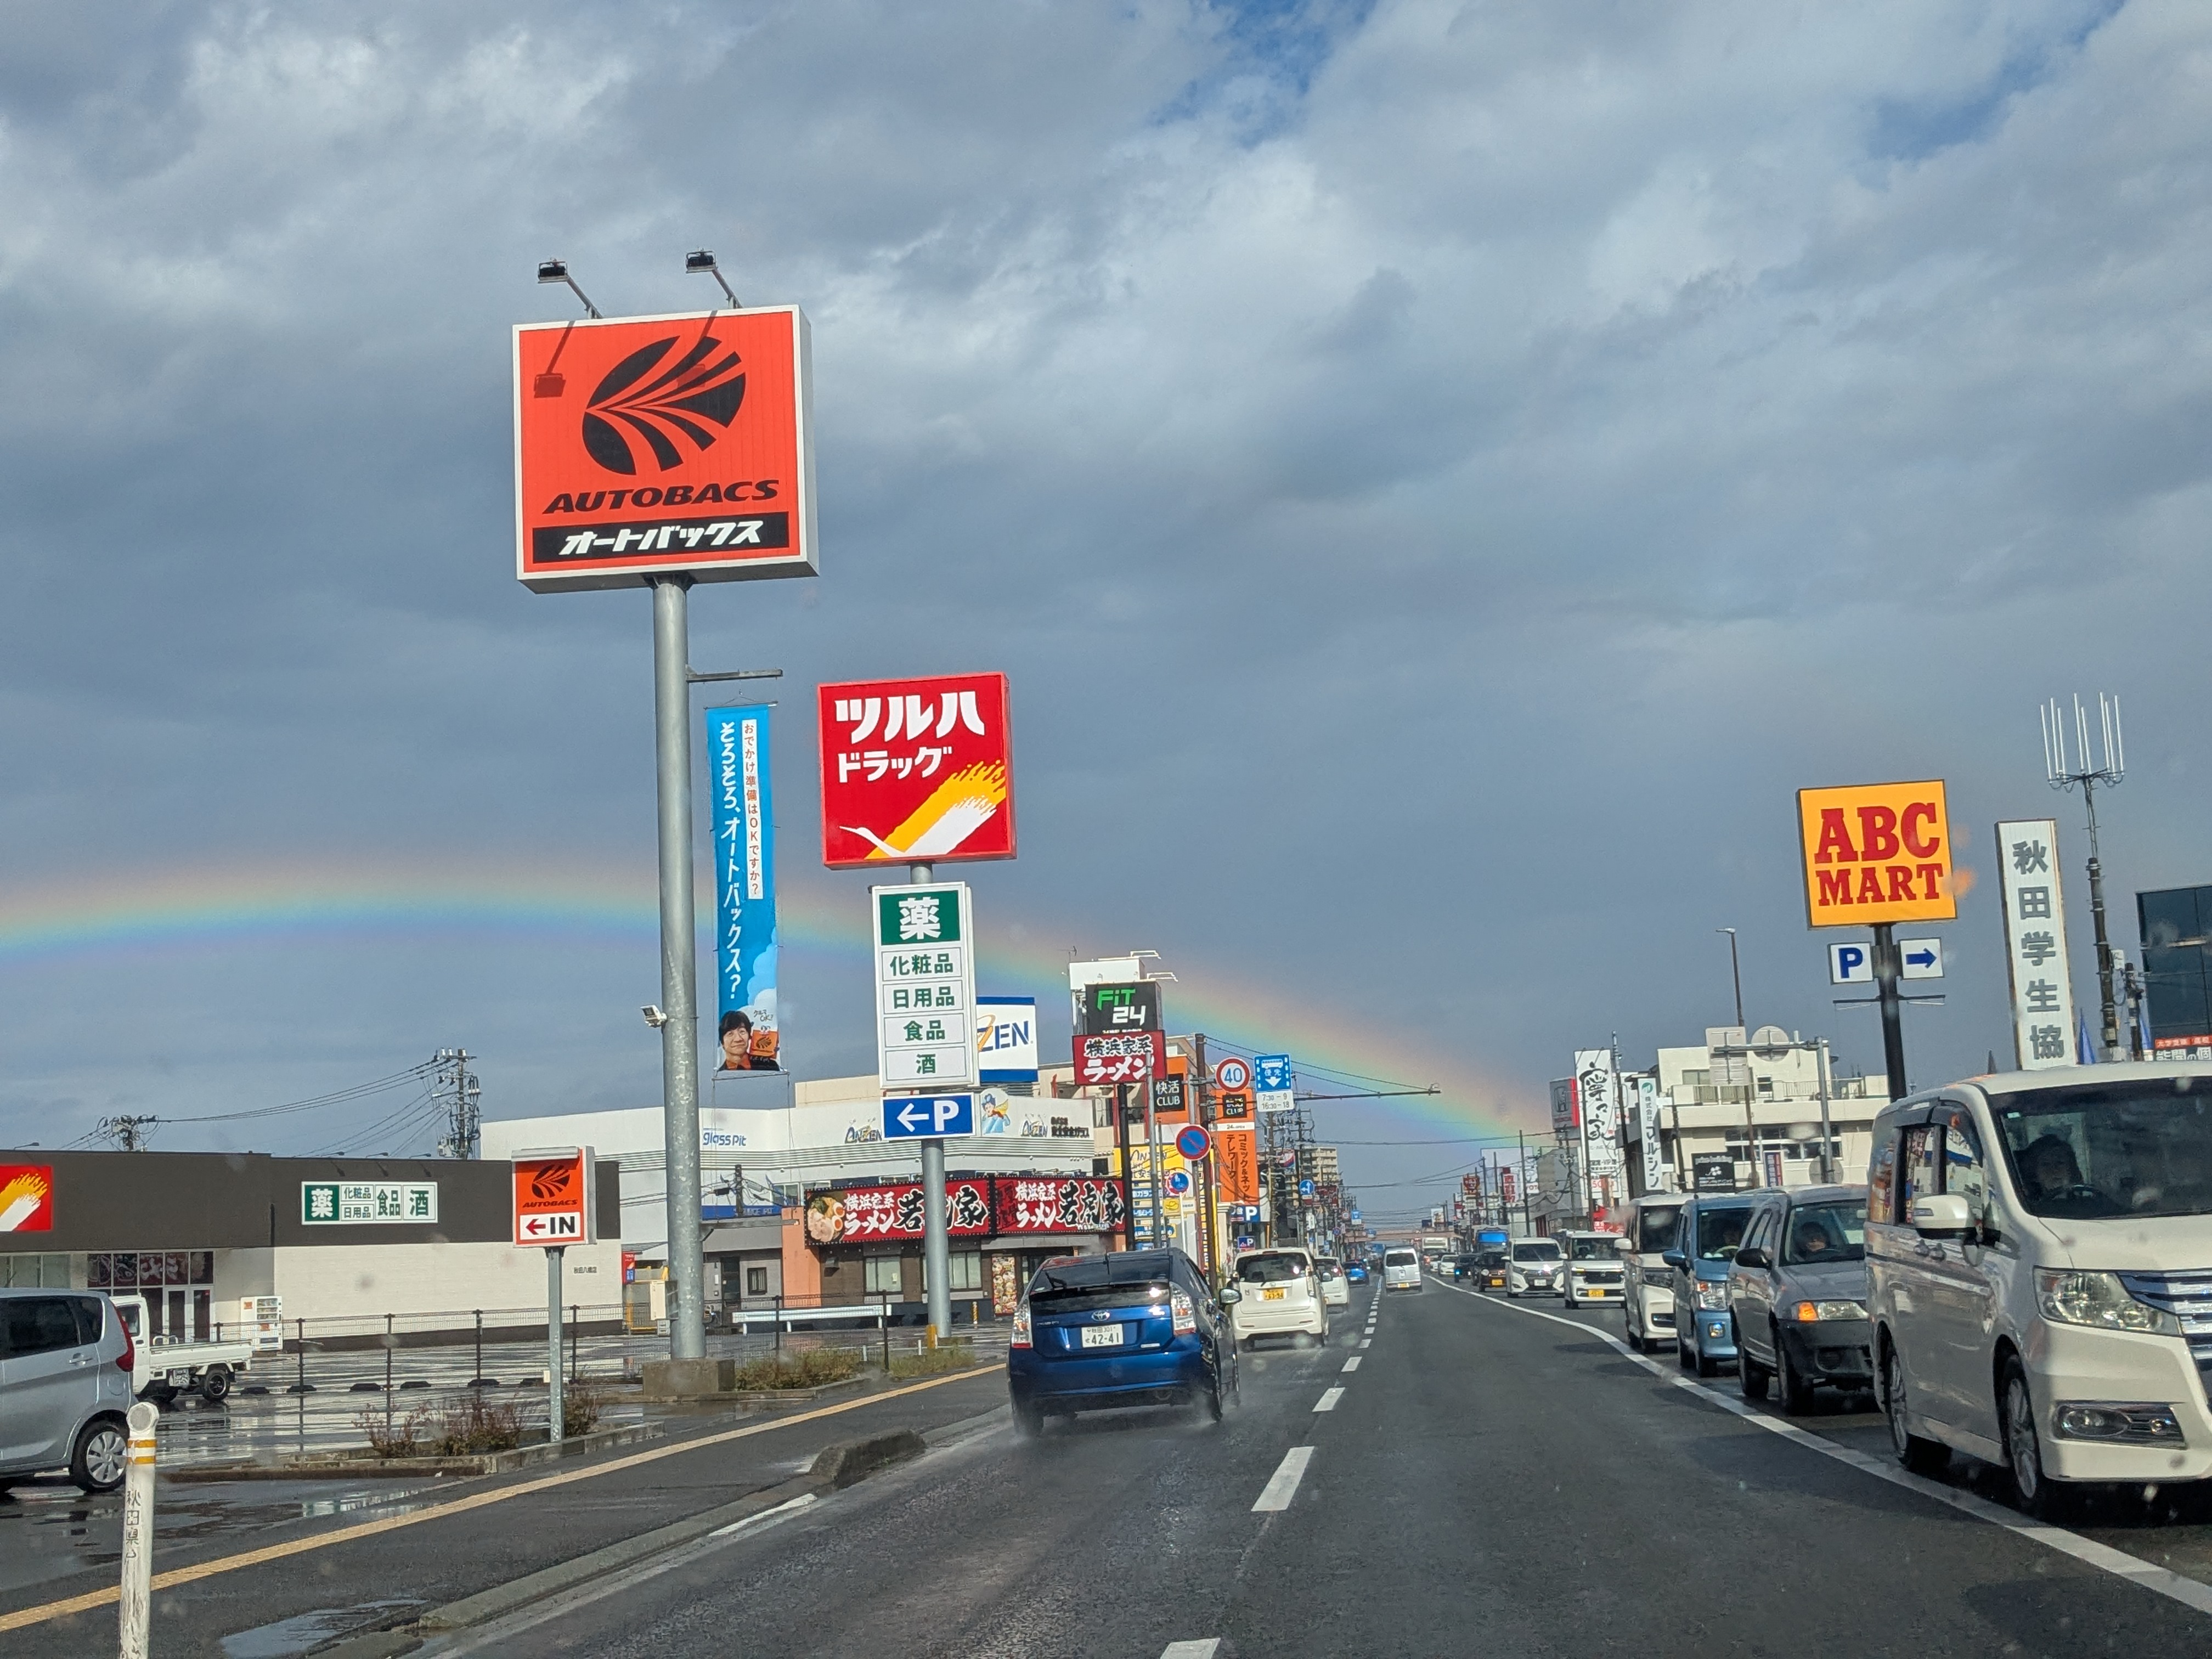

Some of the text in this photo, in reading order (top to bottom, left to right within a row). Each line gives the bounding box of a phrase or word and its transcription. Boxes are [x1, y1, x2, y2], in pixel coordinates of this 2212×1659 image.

[542, 479, 779, 514] AUTOBACS
[558, 521, 764, 555] オートバックス
[834, 691, 985, 744] ツルハ
[838, 747, 952, 783] ドラッグ
[1814, 802, 1940, 864] ABC
[1815, 863, 1944, 906] MART
[899, 896, 941, 940] 薬
[2012, 839, 2065, 1060] 秋田学生協
[890, 953, 953, 977] 化粧品
[1838, 947, 1863, 979] P
[893, 986, 955, 1009] 日用品
[1112, 1006, 1146, 1026] 24
[904, 1020, 945, 1042] 食品
[1084, 1034, 1153, 1058] 横浜家系
[916, 1053, 936, 1075] 酒
[1084, 1056, 1154, 1082] ラーメン
[1224, 1068, 1243, 1083] 40
[1155, 1080, 1180, 1094] 快活
[1156, 1096, 1180, 1106] CLUB
[934, 1099, 959, 1131] P
[1646, 1126, 1658, 1187] マルシン
[311, 1188, 333, 1217] 薬
[344, 1187, 371, 1199] 化粧品
[377, 1189, 400, 1216] 食品
[409, 1189, 429, 1216] 酒
[522, 1199, 578, 1208] AUTOBACS
[844, 1192, 895, 1211] 横浜家系
[1015, 1181, 1056, 1201] 横浜家系
[344, 1206, 371, 1218] 日用品
[893, 1185, 989, 1232] 若家
[1017, 1202, 1056, 1228] ラーメン
[1245, 1206, 1257, 1221] P
[550, 1216, 575, 1234] IN
[844, 1210, 895, 1235] ラーメン
[1091, 1333, 1119, 1345] 42-41
